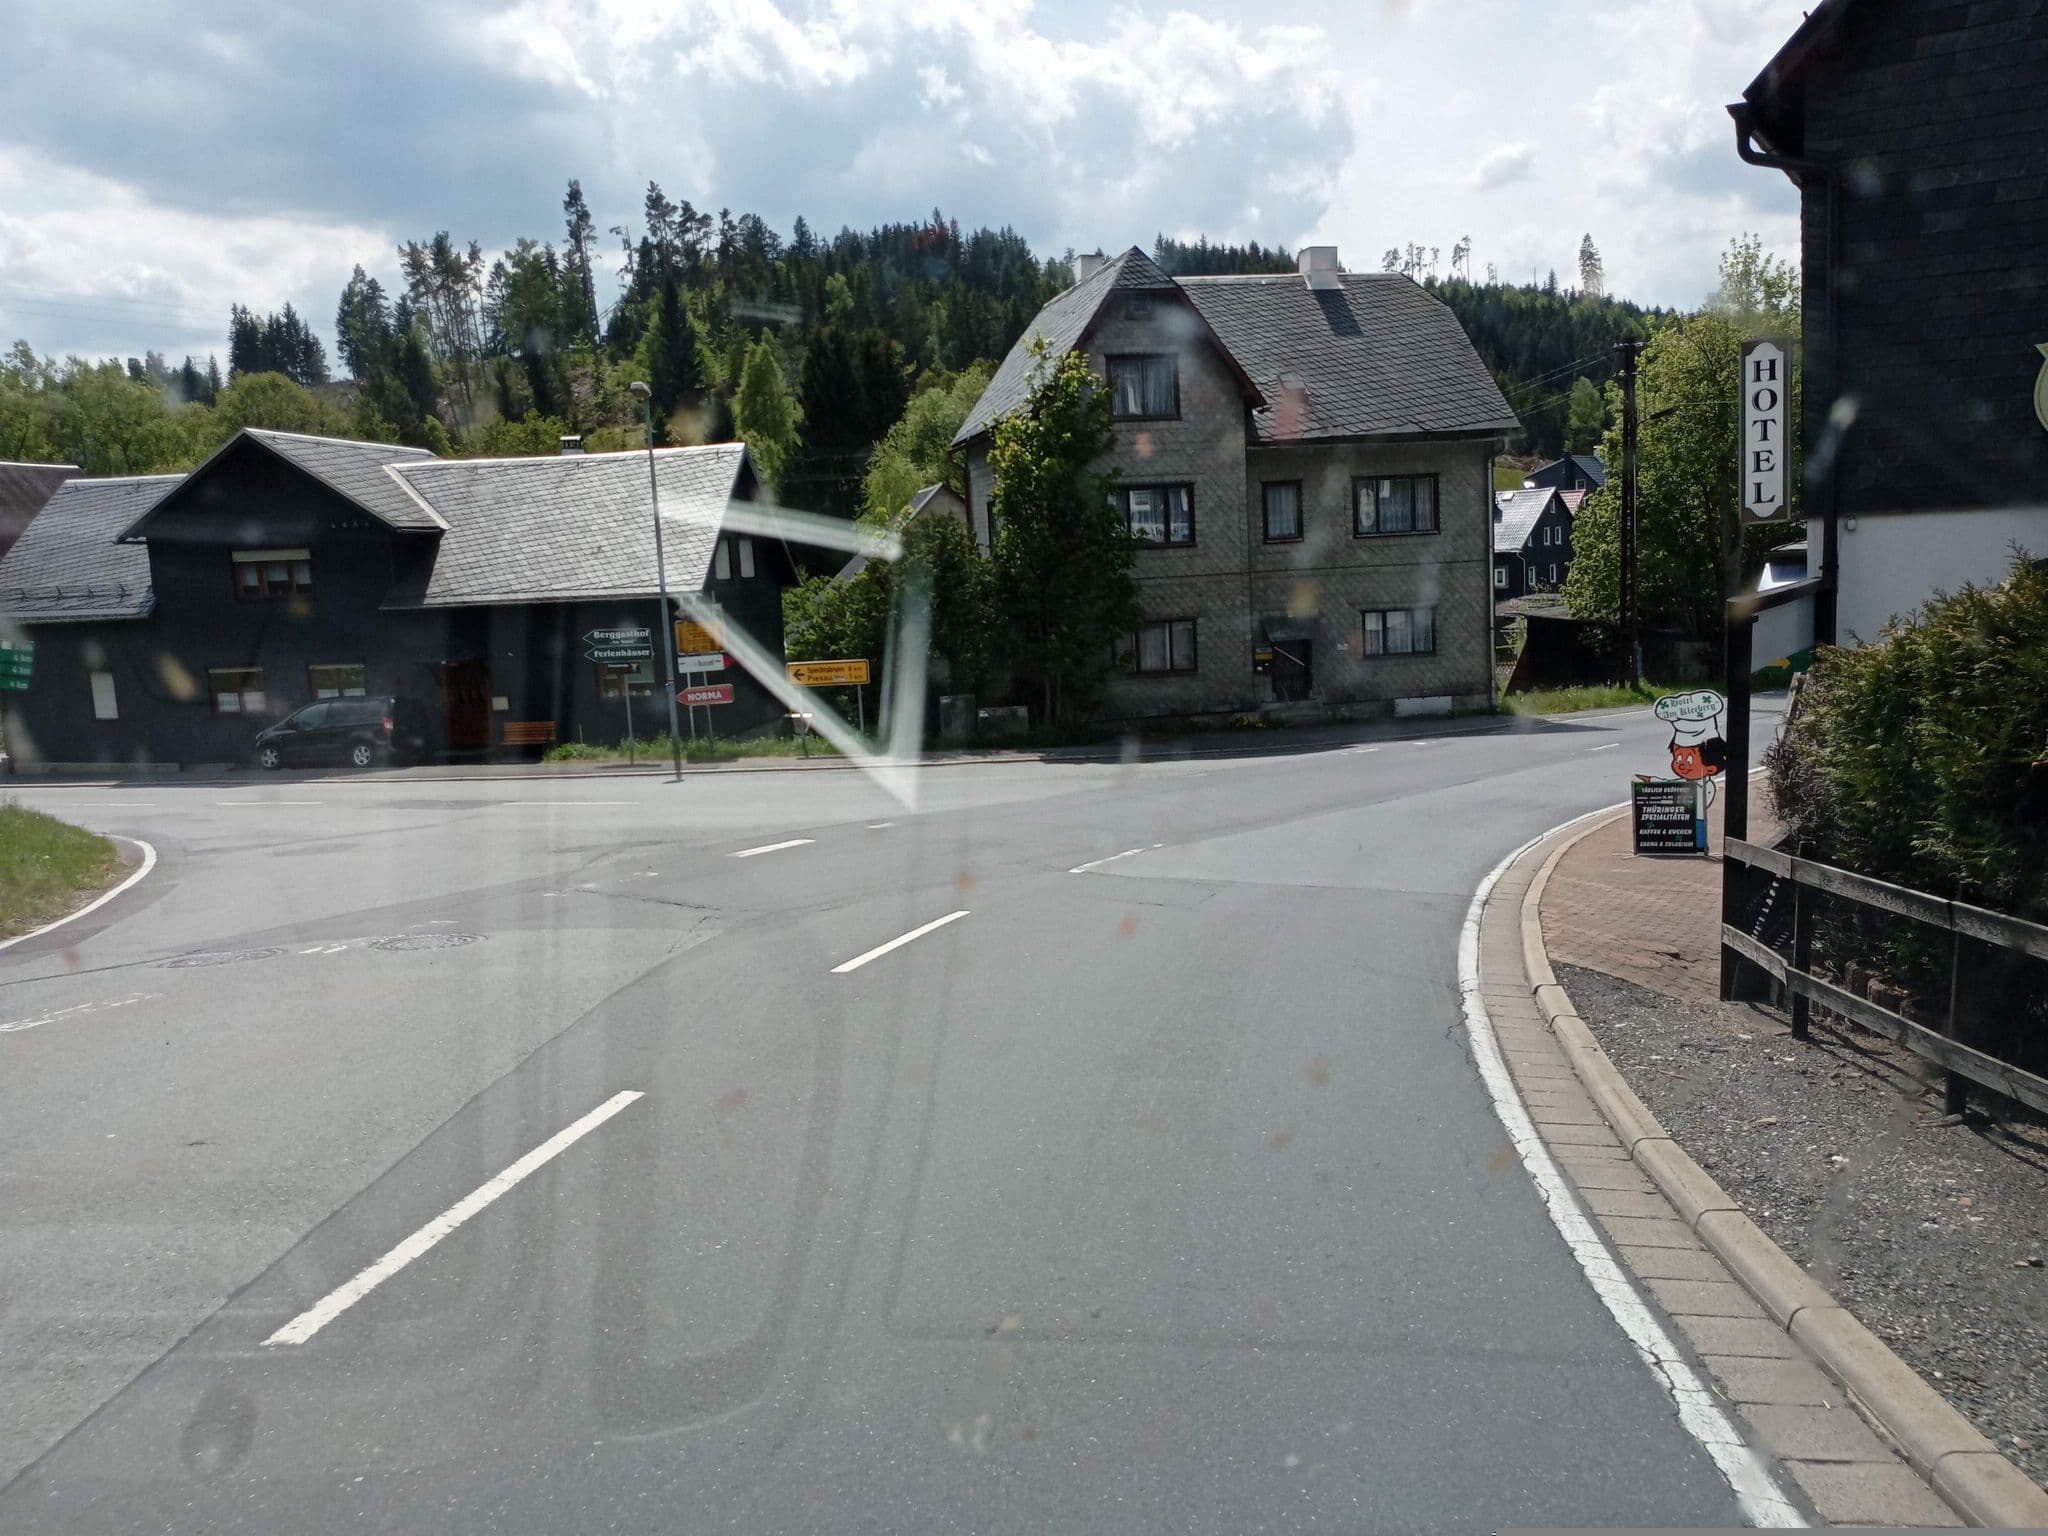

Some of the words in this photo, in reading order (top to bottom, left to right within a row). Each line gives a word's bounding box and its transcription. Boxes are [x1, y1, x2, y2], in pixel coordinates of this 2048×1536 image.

[1752, 358, 1778, 504] HOTEL
[594, 629, 649, 639] Berggasthof
[594, 649, 650, 658] Ferienhäuser
[687, 690, 722, 701] NORMA
[1671, 695, 1694, 708] Hotel
[1642, 805, 1686, 814] THÜRINGER
[1641, 812, 1690, 821] SPEZIALITÄTEN
